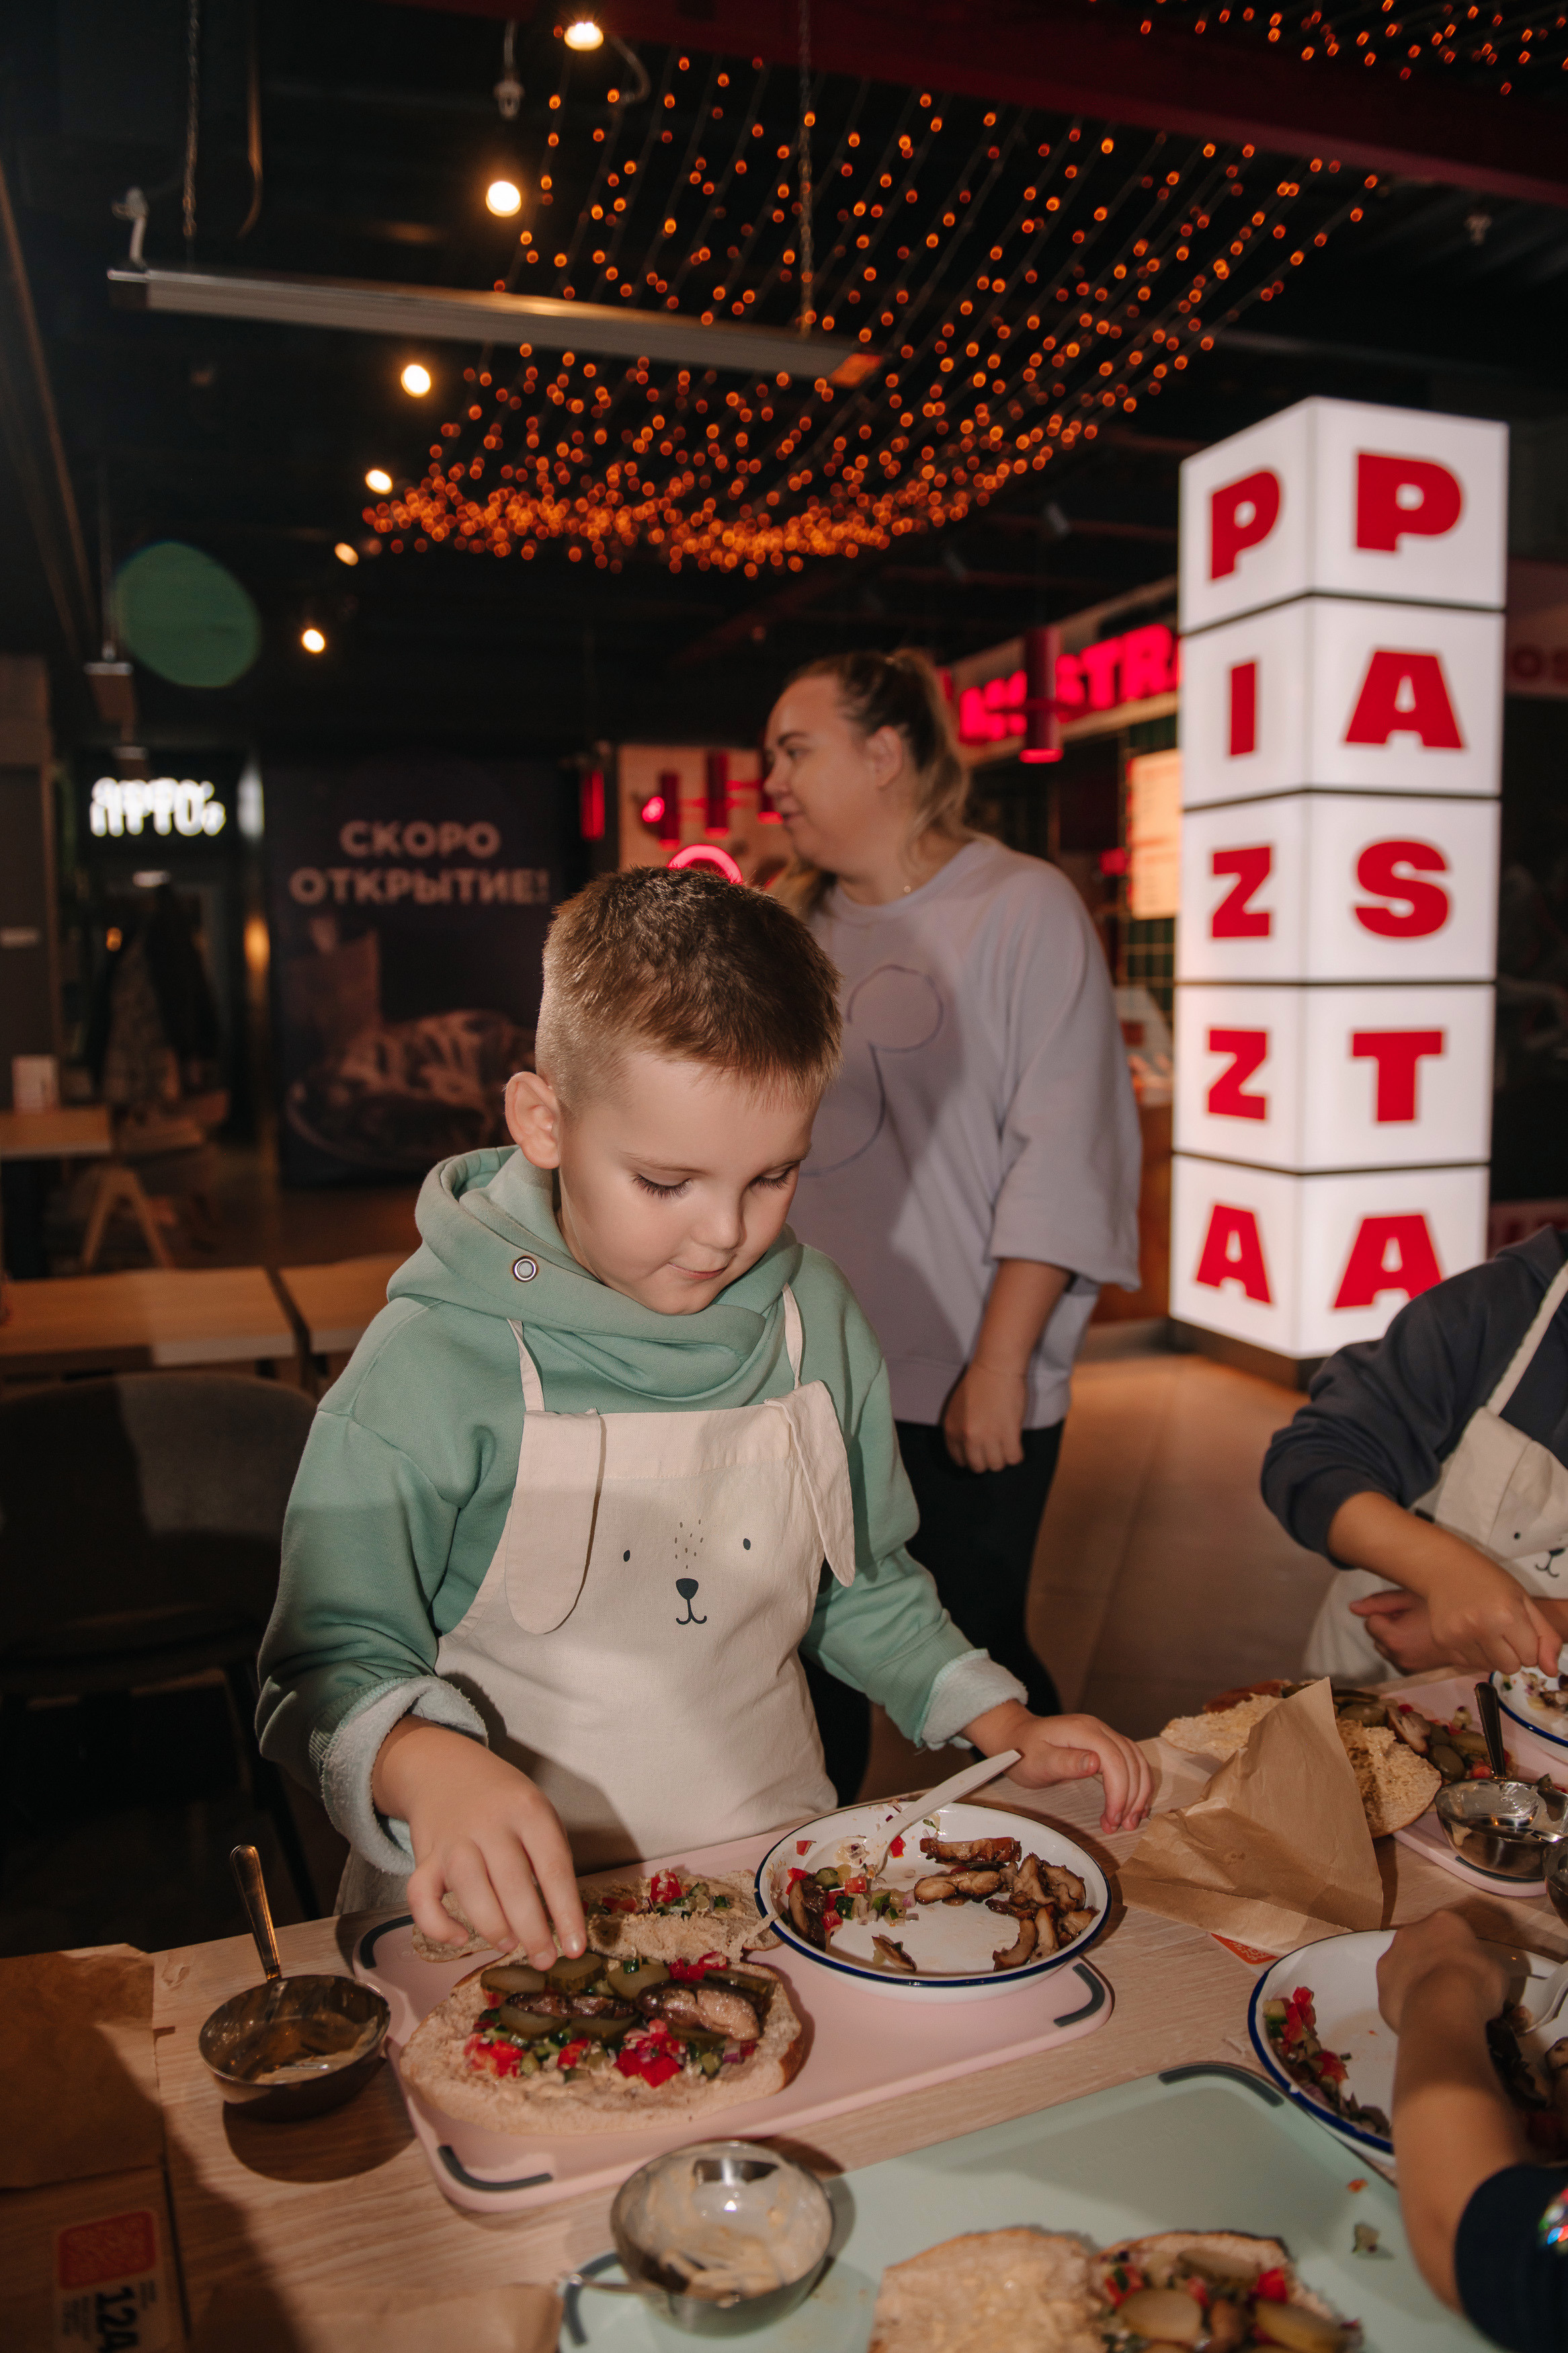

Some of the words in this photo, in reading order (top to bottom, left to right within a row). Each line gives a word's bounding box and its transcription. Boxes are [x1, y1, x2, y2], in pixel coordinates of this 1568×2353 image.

[289, 868, 550, 905] ОТКРЫТИЕ!
[339, 821, 501, 858] СКОРО
[1196, 469, 1282, 1306] PIZZA
[1332, 450, 1467, 1311] PASTA
